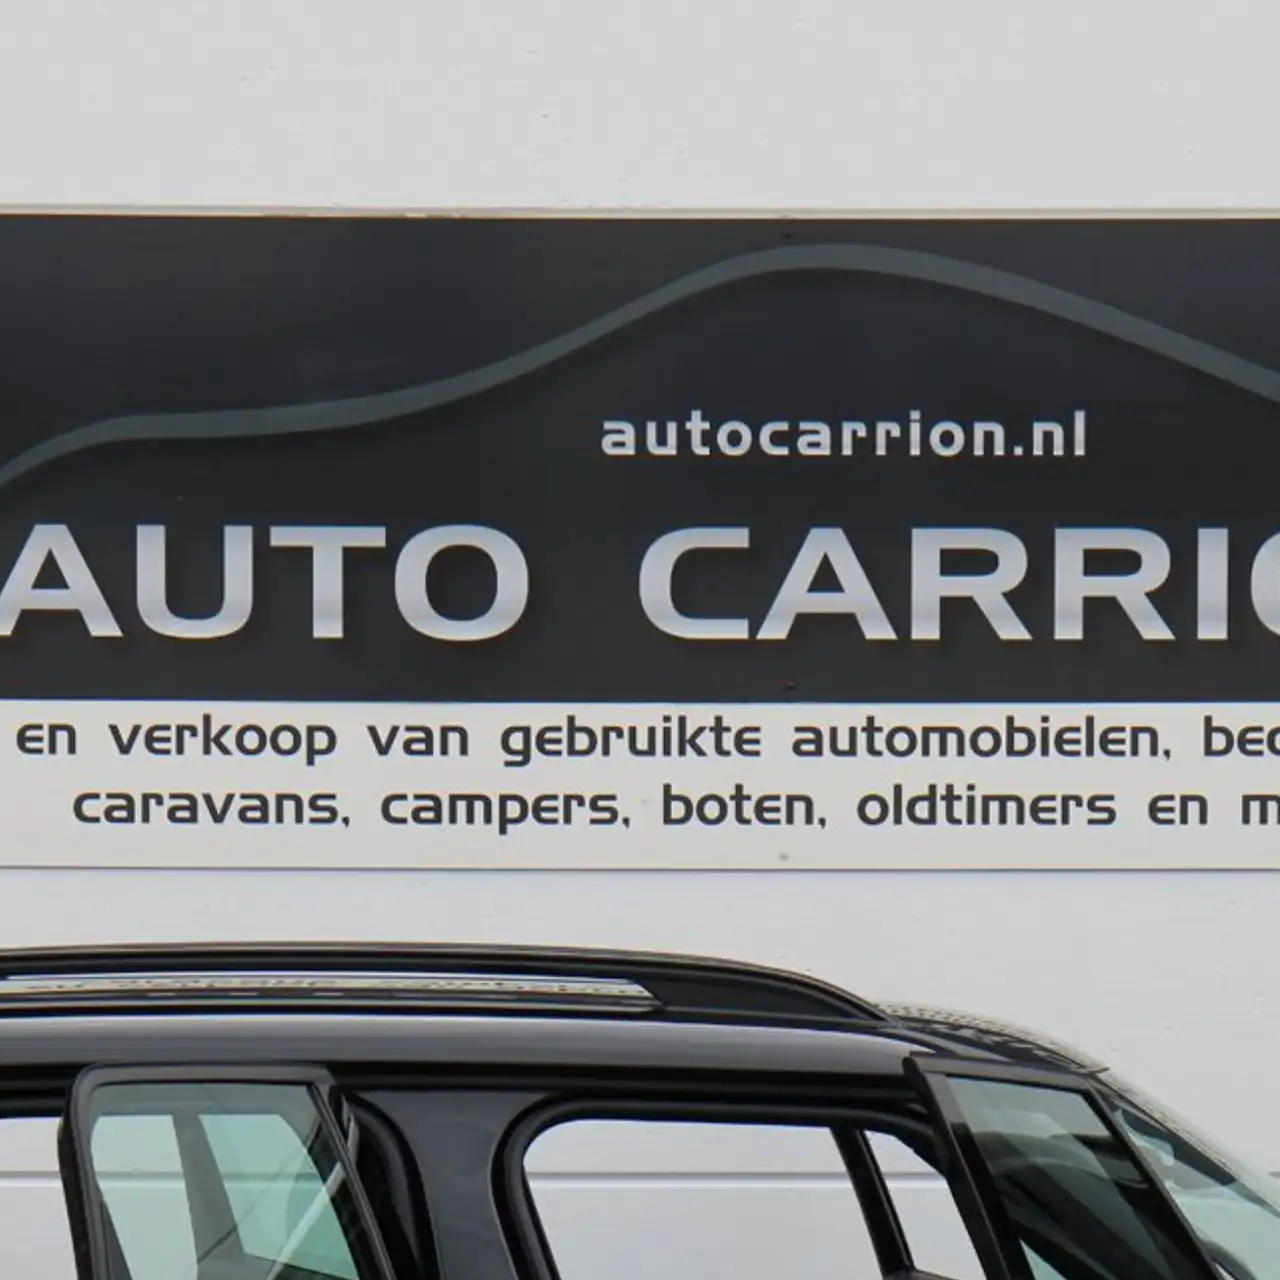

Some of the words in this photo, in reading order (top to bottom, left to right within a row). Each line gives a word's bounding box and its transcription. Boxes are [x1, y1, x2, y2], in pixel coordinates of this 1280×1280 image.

[601, 410, 1085, 457] autocarrion.nl
[16, 723, 77, 755] en
[108, 713, 337, 767] verkoop
[366, 725, 469, 757] van
[500, 714, 761, 768] gebruikte
[791, 715, 1171, 760] automobielen,
[72, 792, 350, 828] caravans,
[380, 793, 630, 836] campers,
[662, 783, 826, 829] boten,
[857, 783, 1117, 826] oldtimers
[1147, 794, 1208, 826] en
